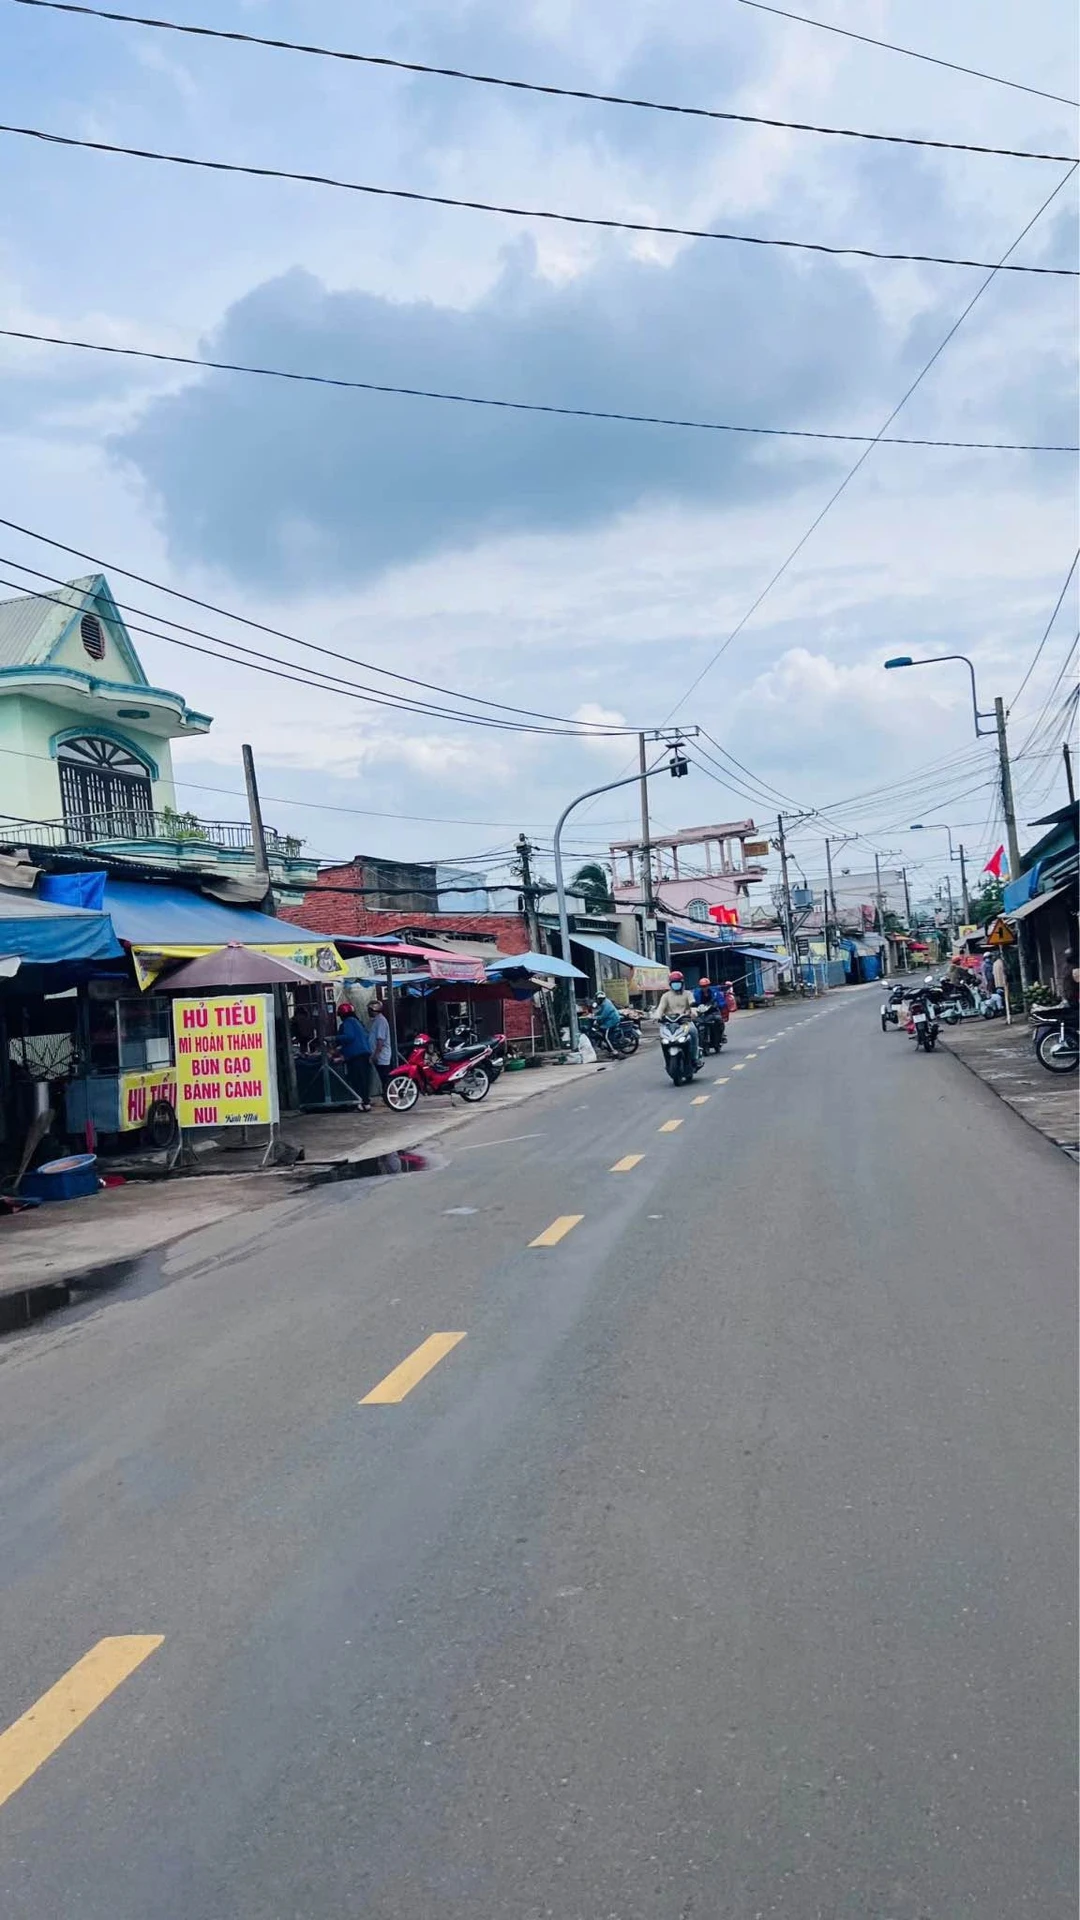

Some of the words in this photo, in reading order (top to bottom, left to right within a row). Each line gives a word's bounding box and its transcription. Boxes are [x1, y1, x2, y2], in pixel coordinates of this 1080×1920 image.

[183, 1001, 208, 1028] HỦ
[192, 1055, 220, 1076] BÚN
[224, 1056, 251, 1077] GẠO
[128, 1076, 146, 1121] HỦ
[225, 1080, 262, 1098] CANH
[194, 1107, 217, 1124] NUI
